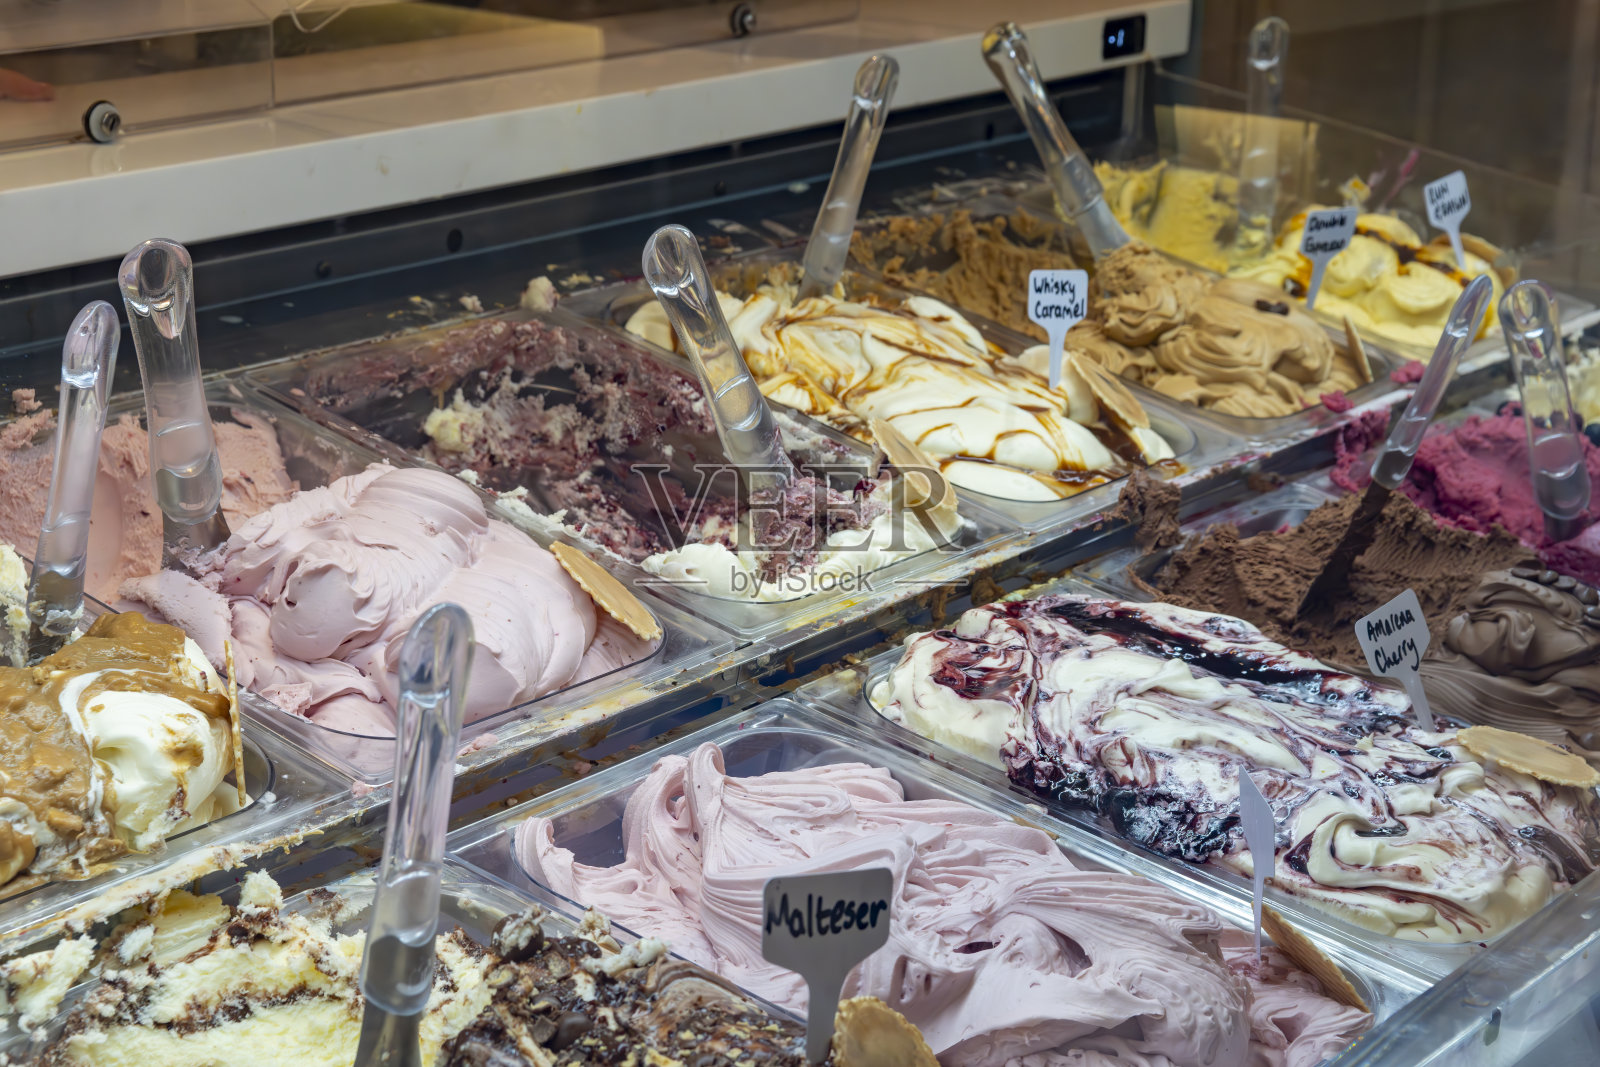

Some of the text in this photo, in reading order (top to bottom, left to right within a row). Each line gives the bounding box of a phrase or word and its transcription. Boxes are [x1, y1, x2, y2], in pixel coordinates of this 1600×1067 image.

[1033, 276, 1076, 304] Whisky
[1034, 298, 1084, 319] Caramel
[1374, 638, 1419, 674] Cherry
[765, 893, 888, 938] Malteser
